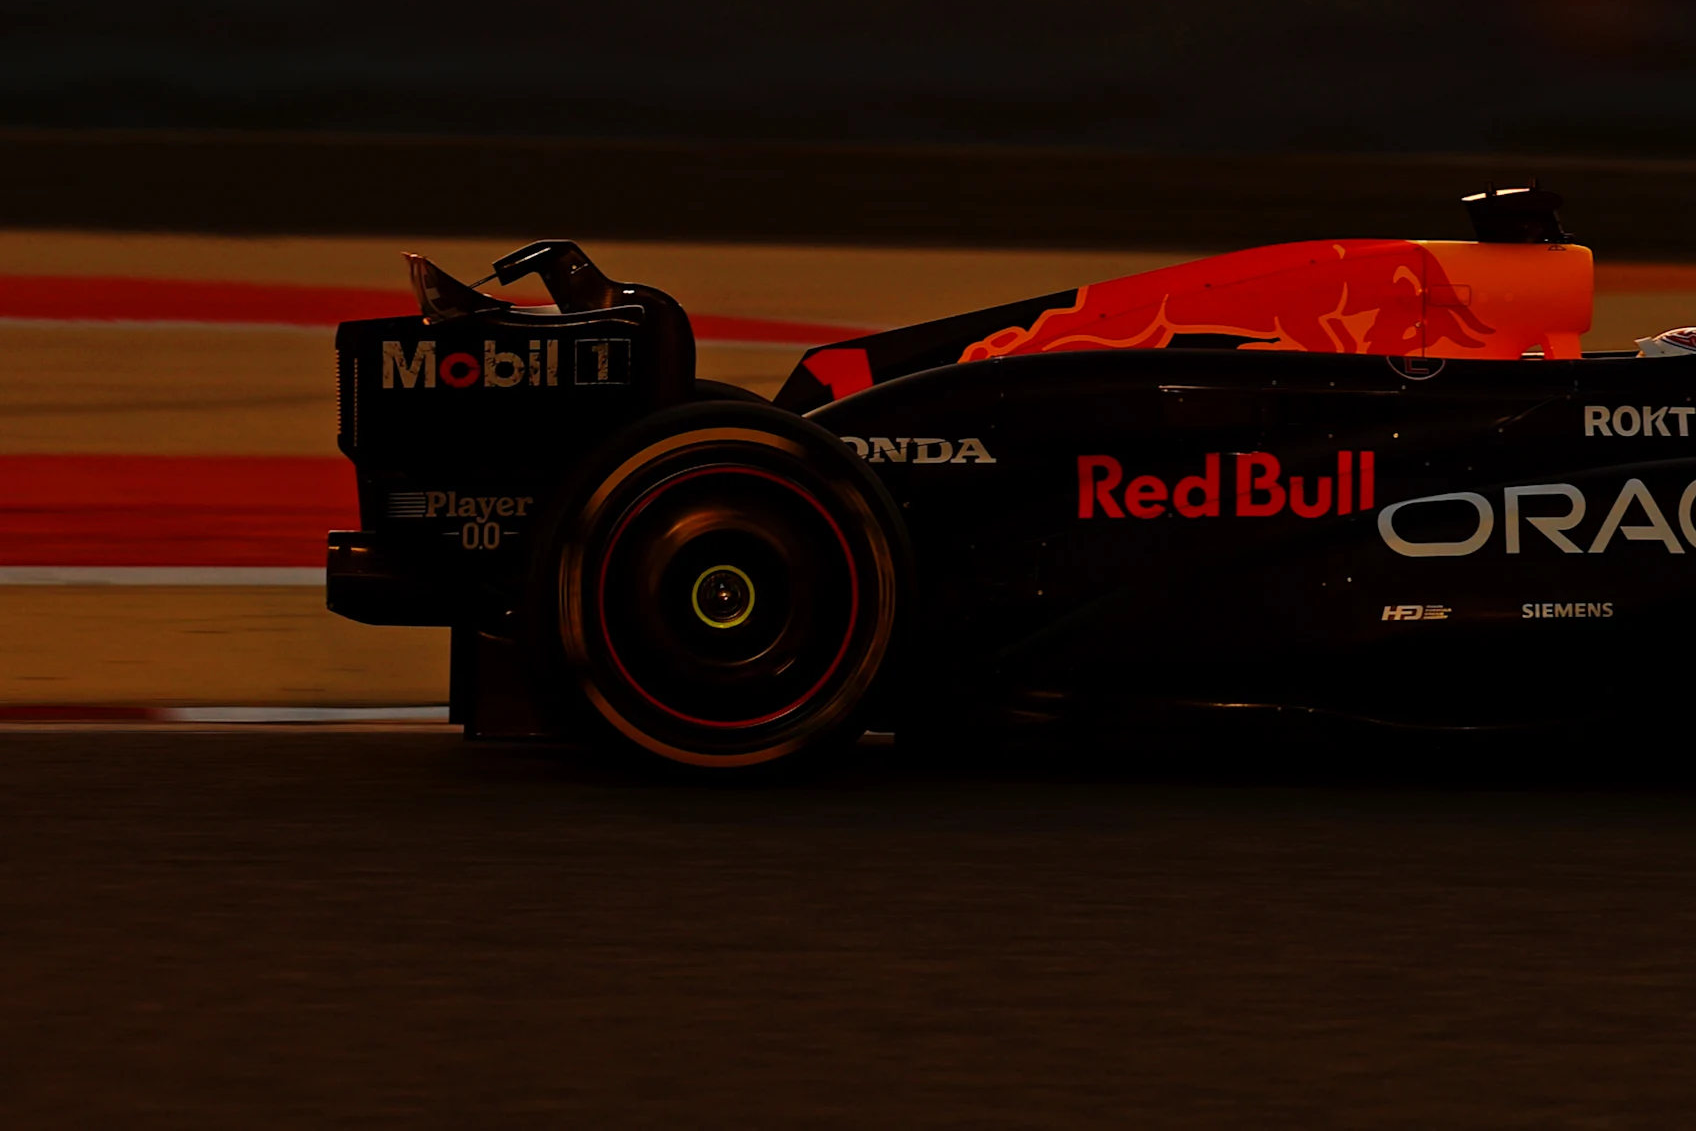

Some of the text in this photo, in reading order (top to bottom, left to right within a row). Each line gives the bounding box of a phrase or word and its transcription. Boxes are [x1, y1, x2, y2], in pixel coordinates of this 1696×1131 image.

[382, 339, 609, 389] Mobil 1
[1584, 405, 1696, 437] ROKT
[1076, 449, 1376, 519] Red Bull
[425, 490, 535, 524] Player
[1521, 602, 1614, 619] SIEMENS
